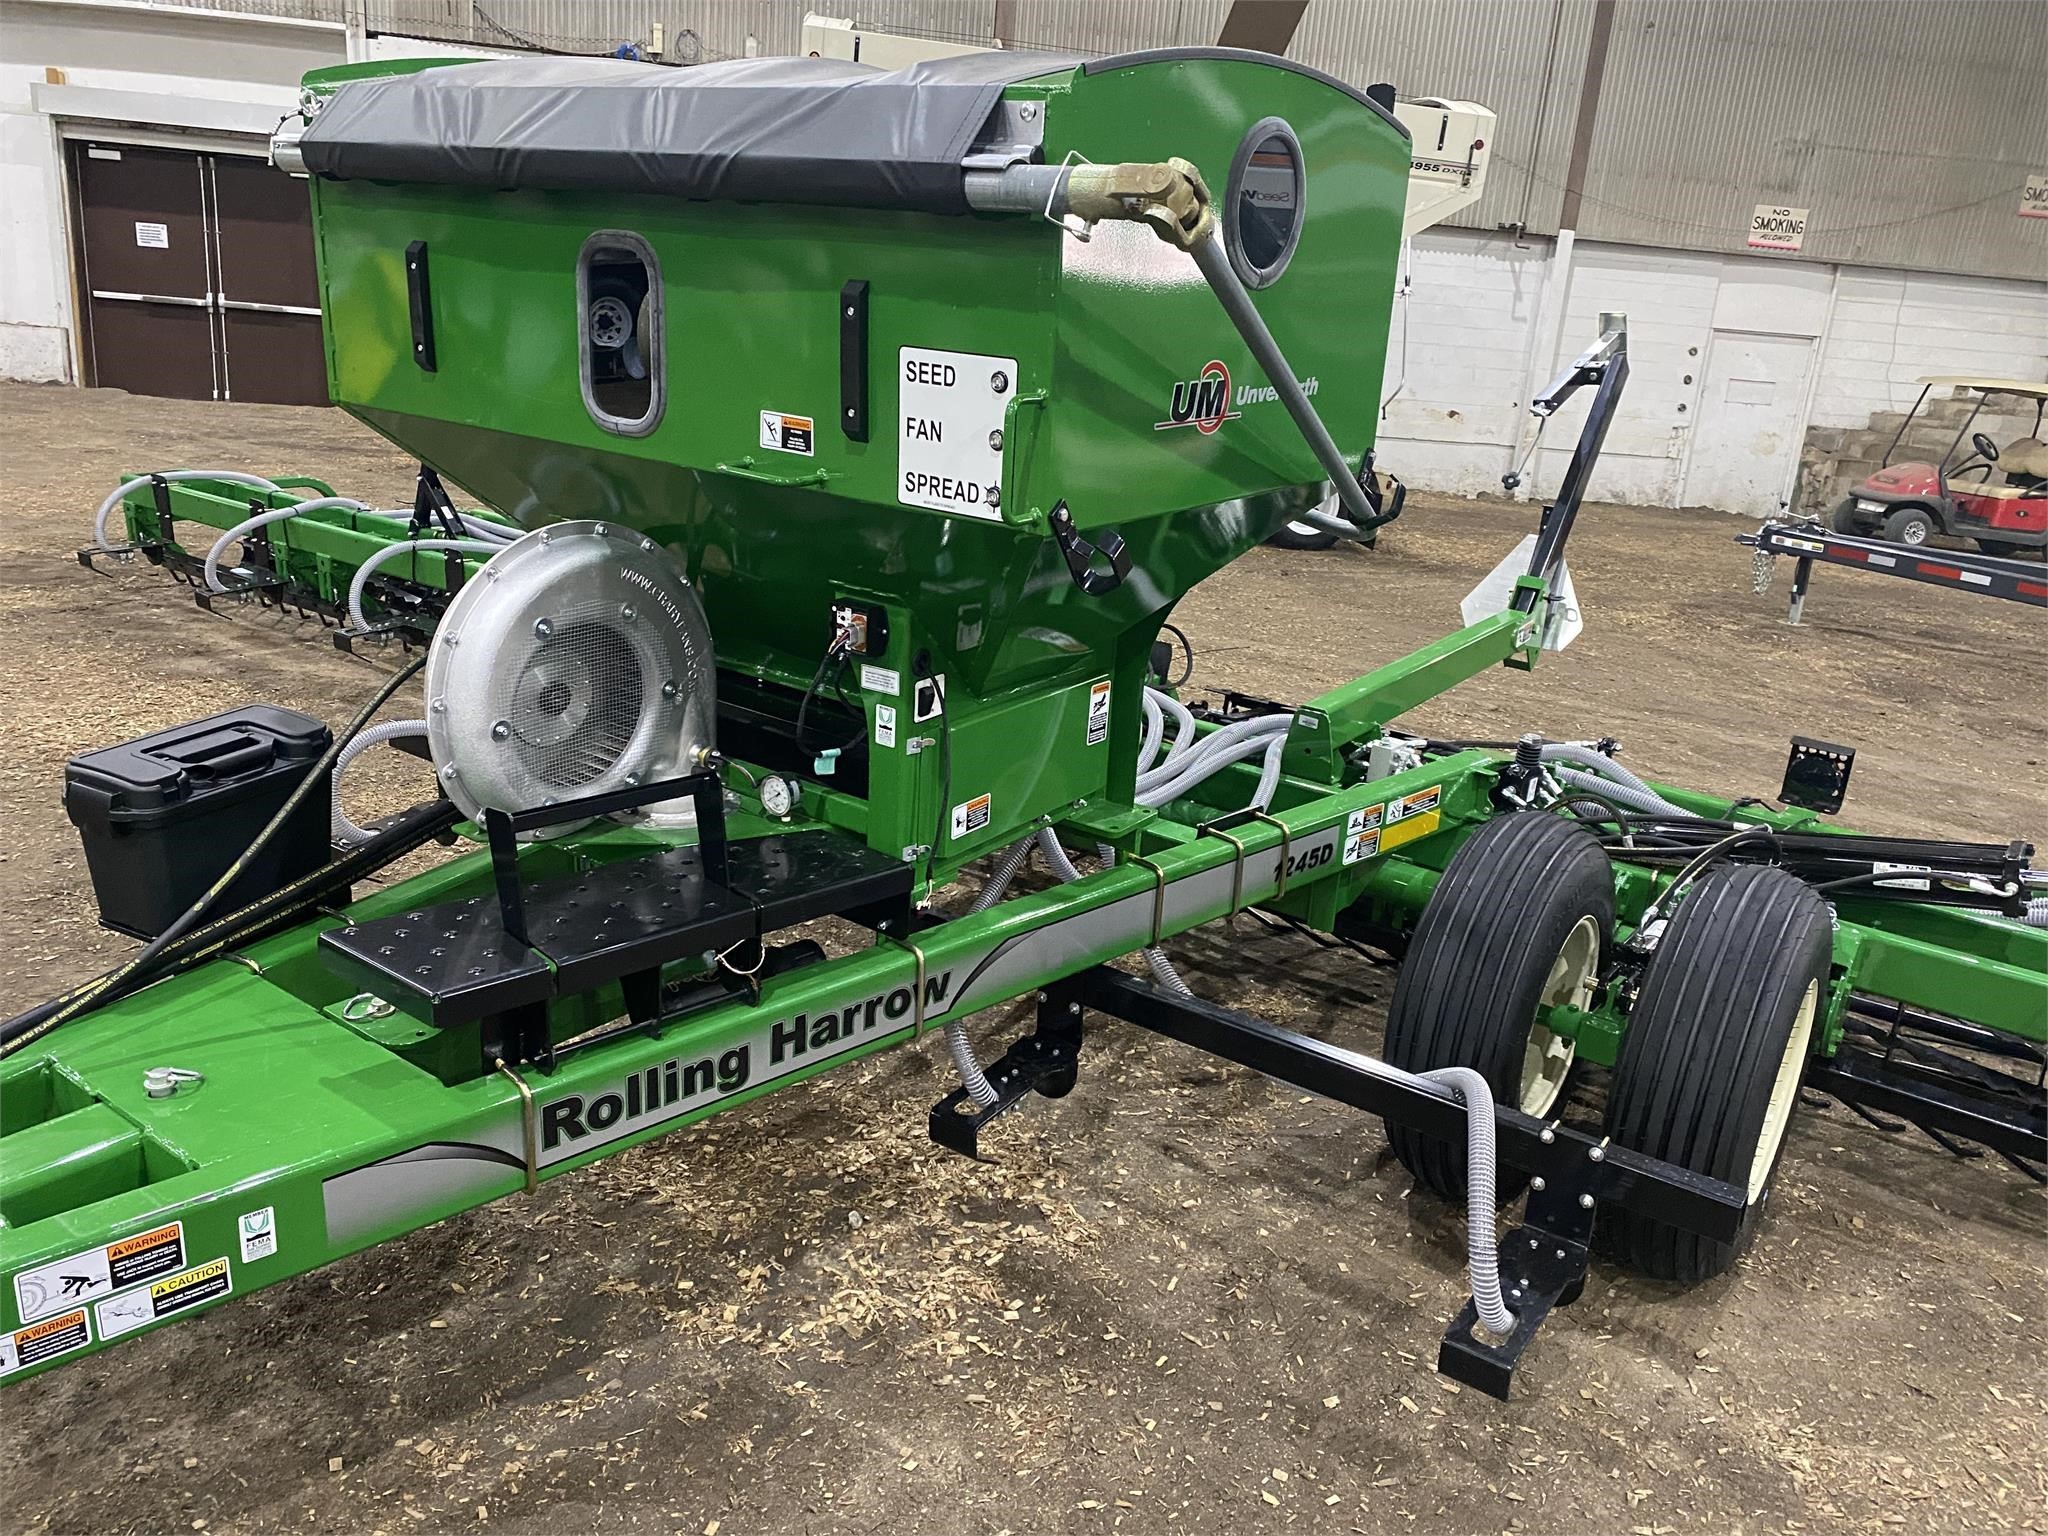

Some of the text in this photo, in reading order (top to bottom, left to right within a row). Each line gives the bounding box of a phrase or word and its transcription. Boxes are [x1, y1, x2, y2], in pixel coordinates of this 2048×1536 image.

[1752, 216, 1804, 234] SMOKING
[906, 360, 956, 387] SEED
[1170, 378, 1227, 423] UM
[906, 417, 942, 443] FAN
[905, 471, 979, 503] SPREAD
[1273, 843, 1333, 882] 1245D
[20, 1030, 34, 1041] PSI
[33, 1016, 58, 1033] FLAME
[57, 991, 94, 1019] RESISTANT
[541, 969, 953, 1152] Rolling Harrow
[124, 1229, 177, 1252] WARNING
[247, 1236, 271, 1249] FEMA
[168, 1263, 223, 1289] CAUTION
[31, 1314, 80, 1337] WARNING
